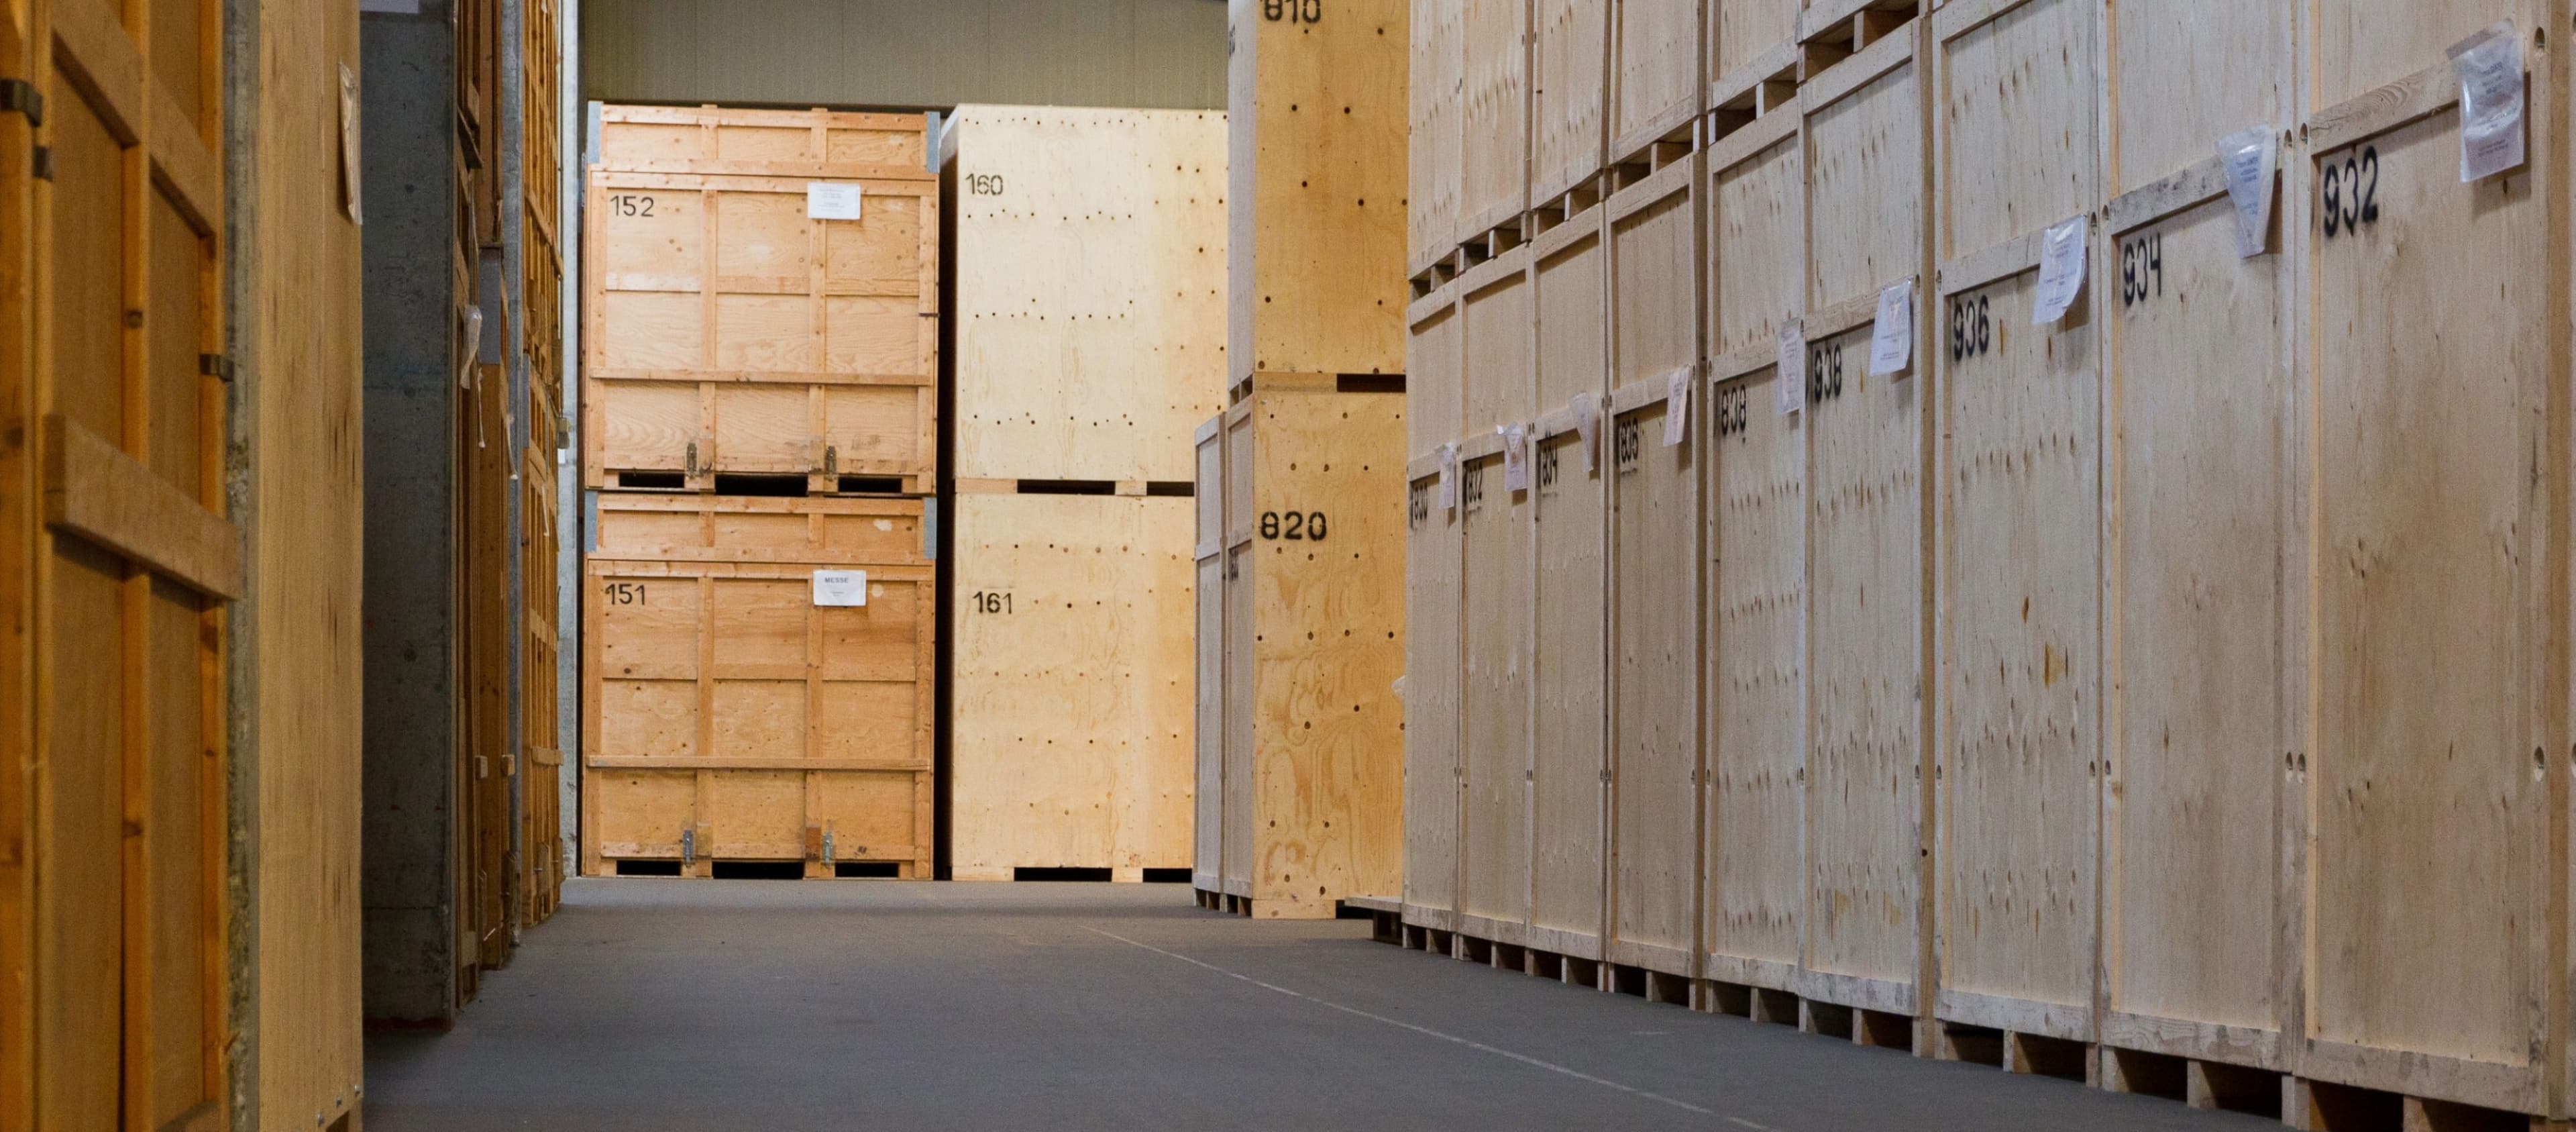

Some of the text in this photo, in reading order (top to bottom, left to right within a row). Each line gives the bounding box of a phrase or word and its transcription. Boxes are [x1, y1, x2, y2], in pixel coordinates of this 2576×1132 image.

[1265, 0, 1321, 24] 810
[965, 173, 1004, 195] 160
[2324, 146, 2378, 236] 932
[610, 195, 654, 217] 152
[2124, 232, 2161, 307] 934
[1954, 295, 1990, 362] 936
[1815, 343, 1841, 404] 938
[1722, 384, 1746, 437] 838
[1260, 511, 1327, 542] 820
[605, 583, 645, 605] 151
[973, 591, 1012, 614] 161
